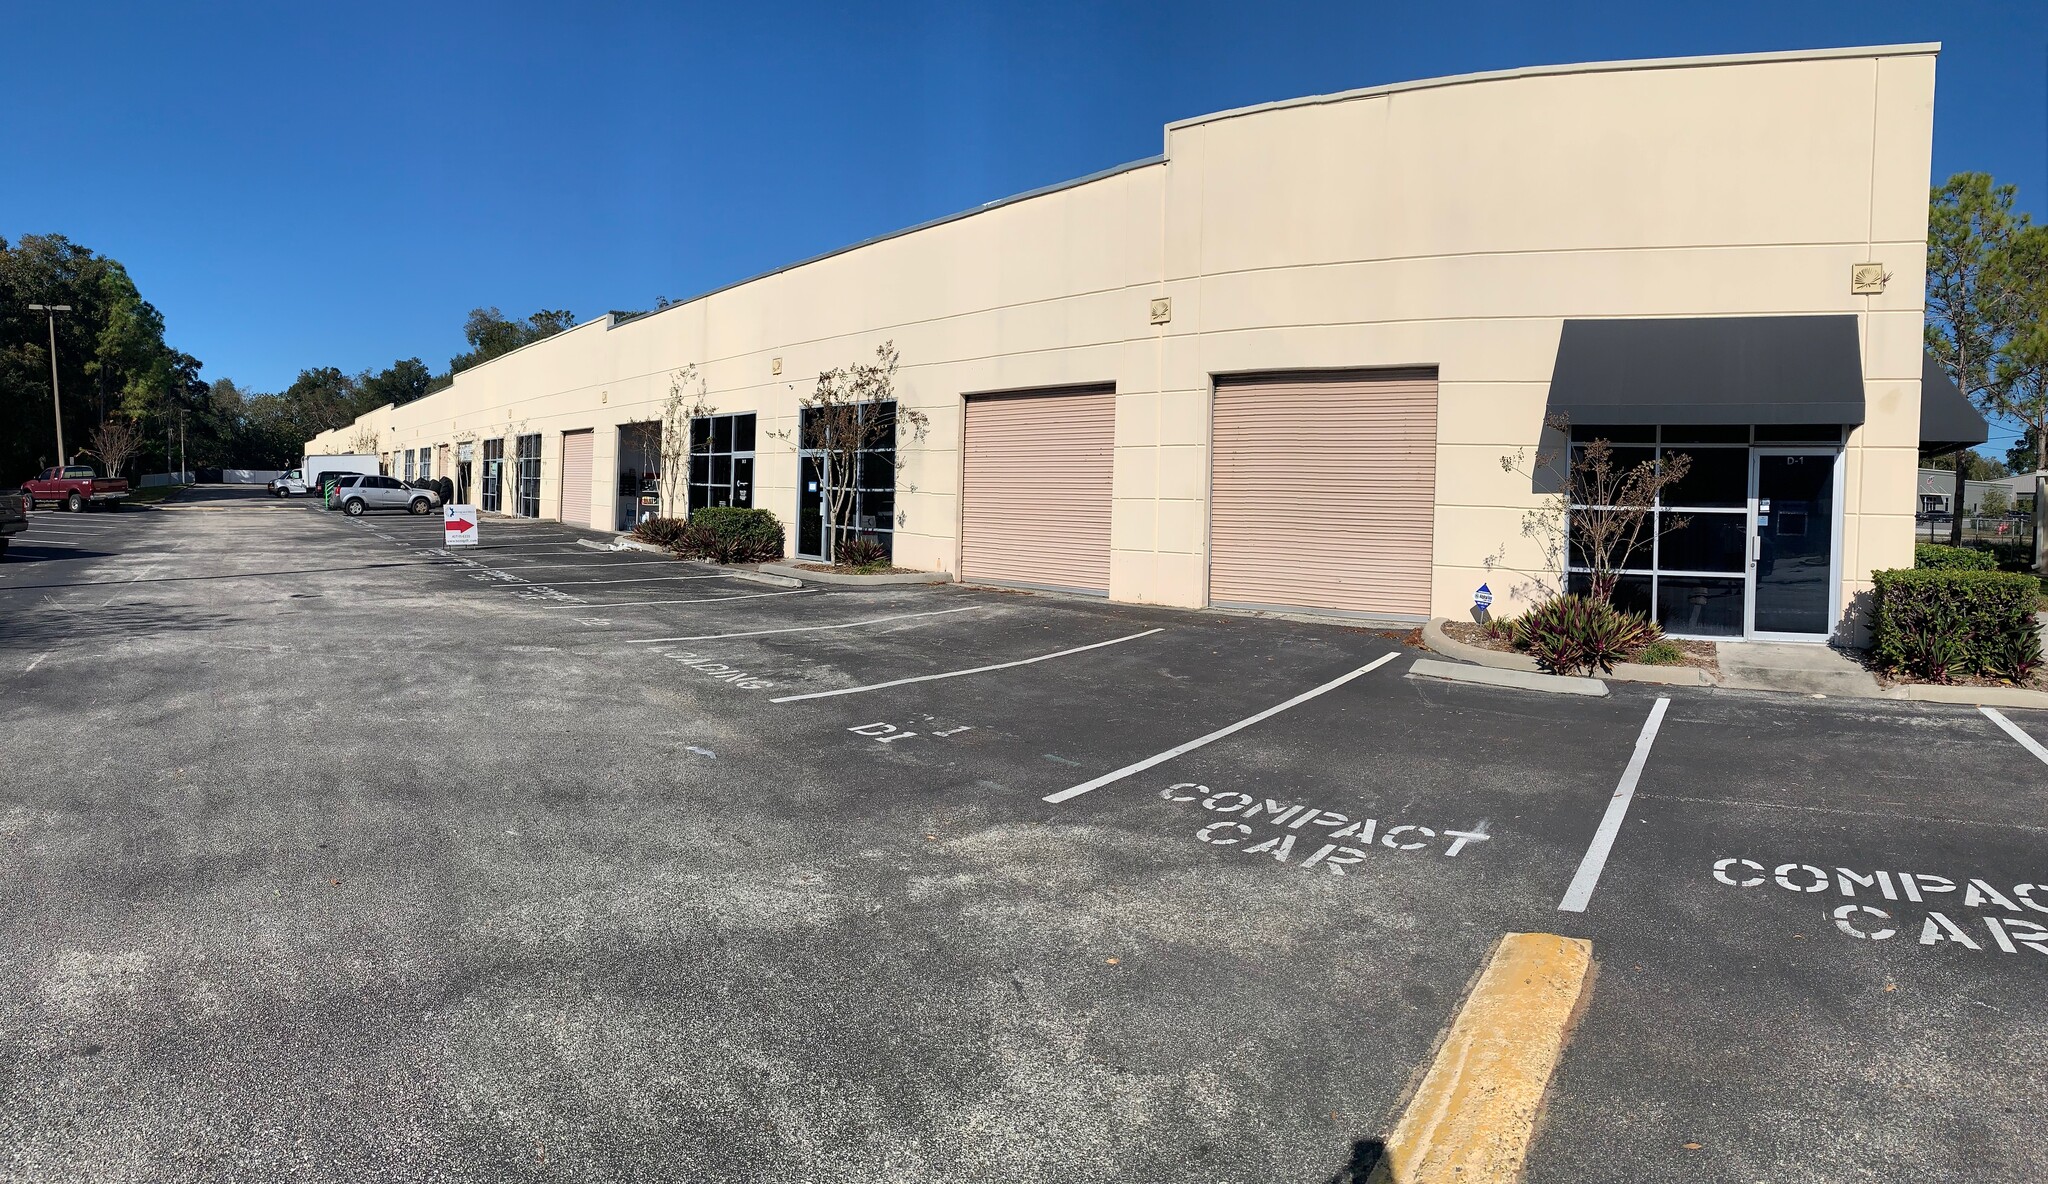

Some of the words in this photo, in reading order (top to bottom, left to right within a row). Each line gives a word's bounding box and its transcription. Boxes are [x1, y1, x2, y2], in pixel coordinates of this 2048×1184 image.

[1787, 456, 1804, 465] D-1
[847, 722, 918, 743] D1
[1158, 782, 1491, 858] COMPACT
[1196, 821, 1367, 877] CAR
[1833, 904, 2048, 956] CAR
